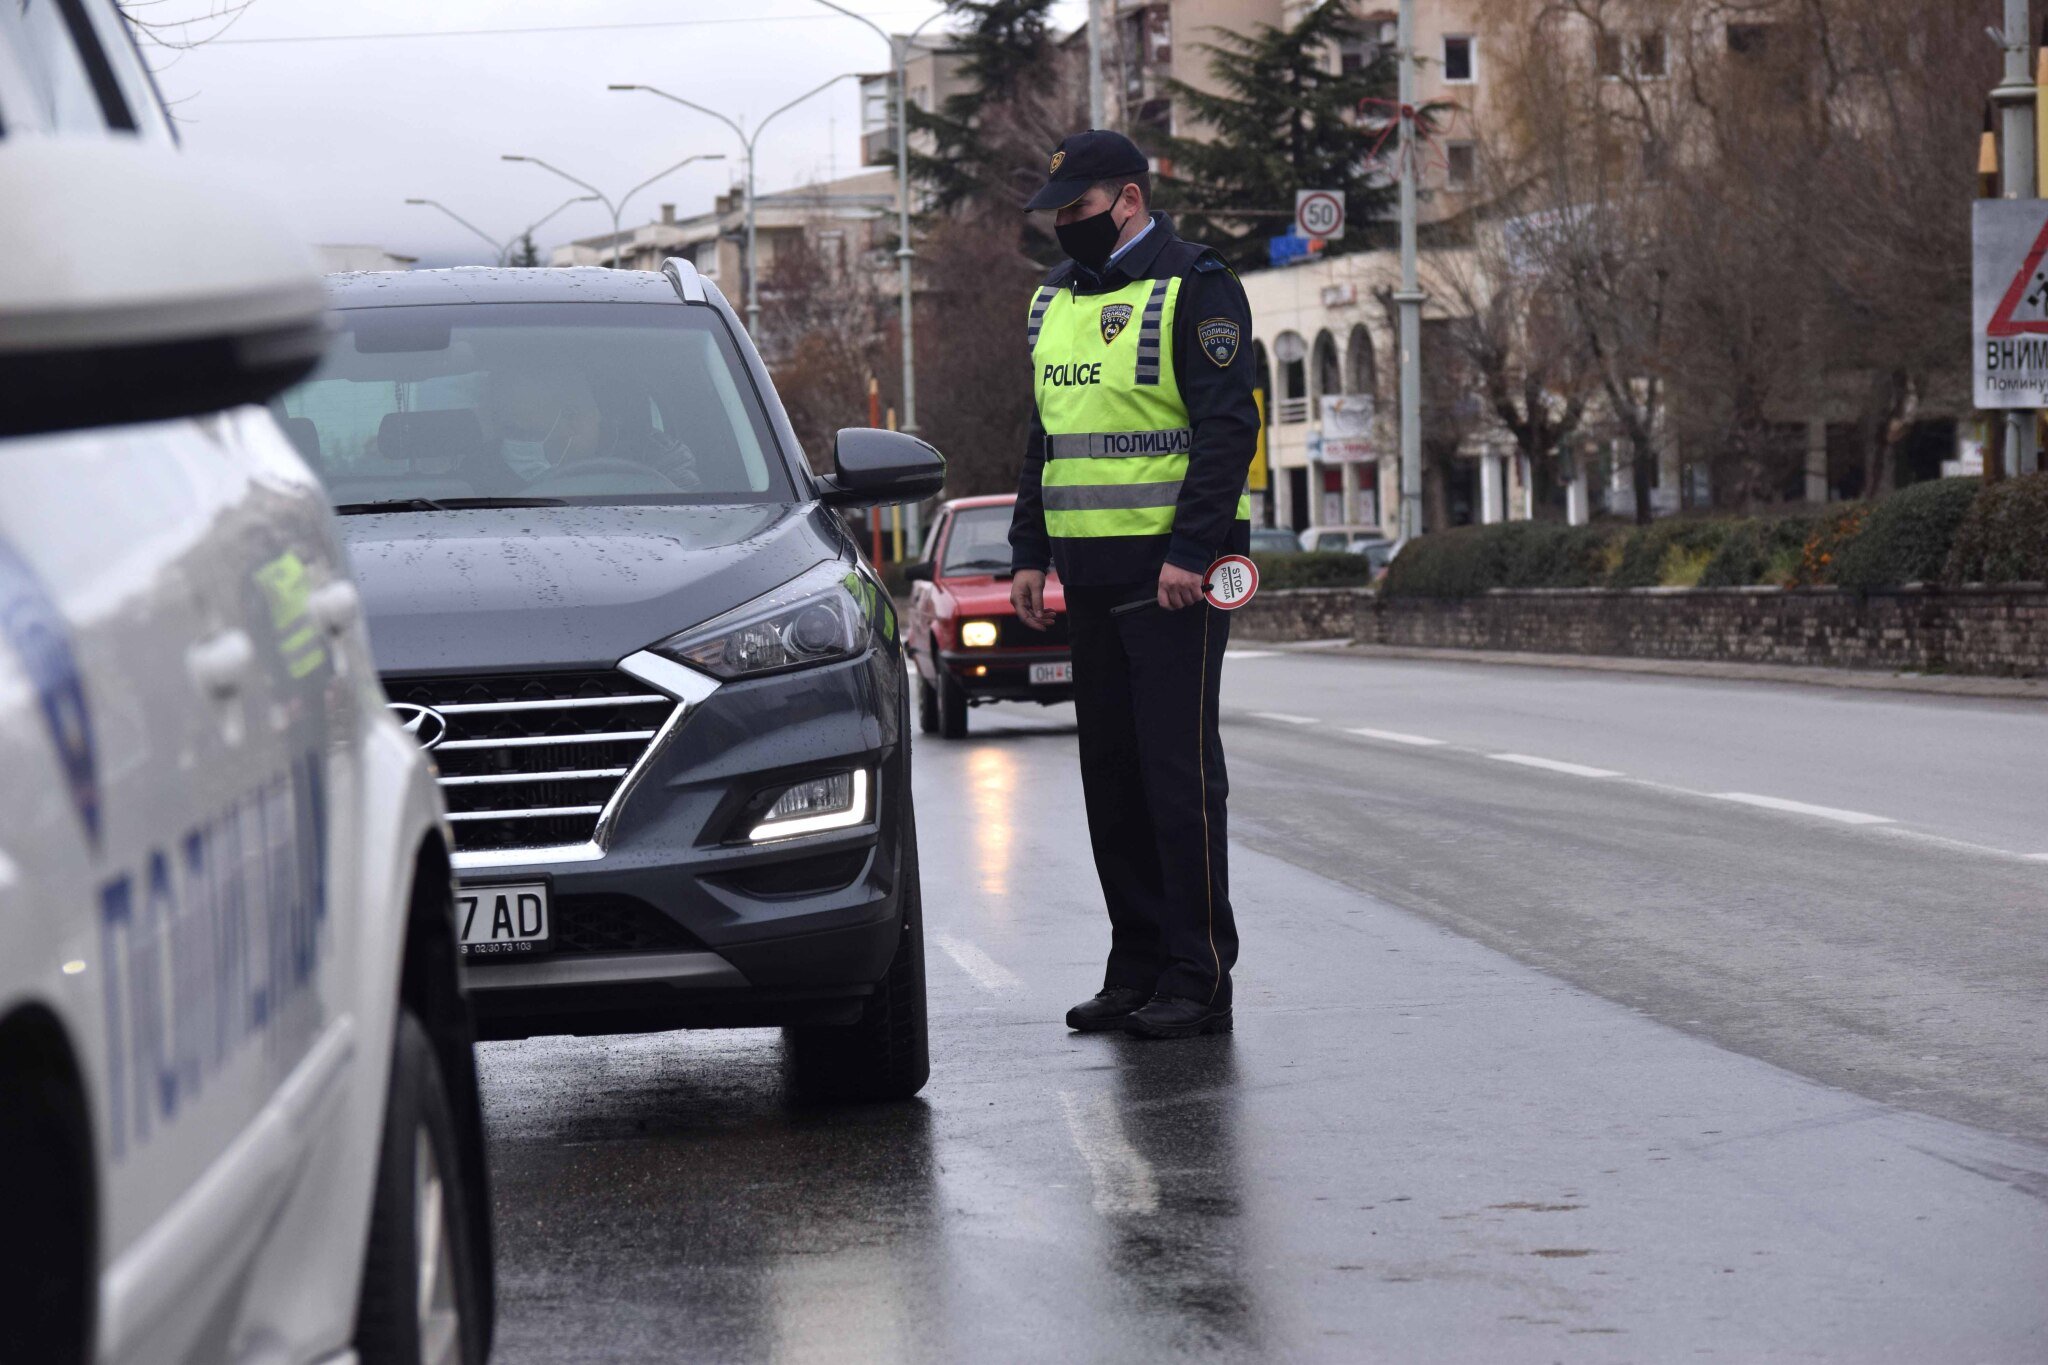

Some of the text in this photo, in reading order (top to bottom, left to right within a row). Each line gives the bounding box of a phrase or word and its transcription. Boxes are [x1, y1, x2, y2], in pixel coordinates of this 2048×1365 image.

[1308, 203, 1333, 226] 50
[1102, 317, 1127, 326] POLICE
[1201, 327, 1237, 339] ПОЛИЦИЈА
[1204, 337, 1236, 348] POLICE
[1986, 340, 2048, 371] ВНИМ
[1043, 362, 1102, 387] POLICE
[1986, 376, 2048, 394] Помину
[1232, 567, 1244, 593] STOP
[455, 893, 542, 941] 7 AD
[474, 943, 500, 953] 02/30
[501, 943, 514, 952] 73
[515, 942, 532, 951] 103
